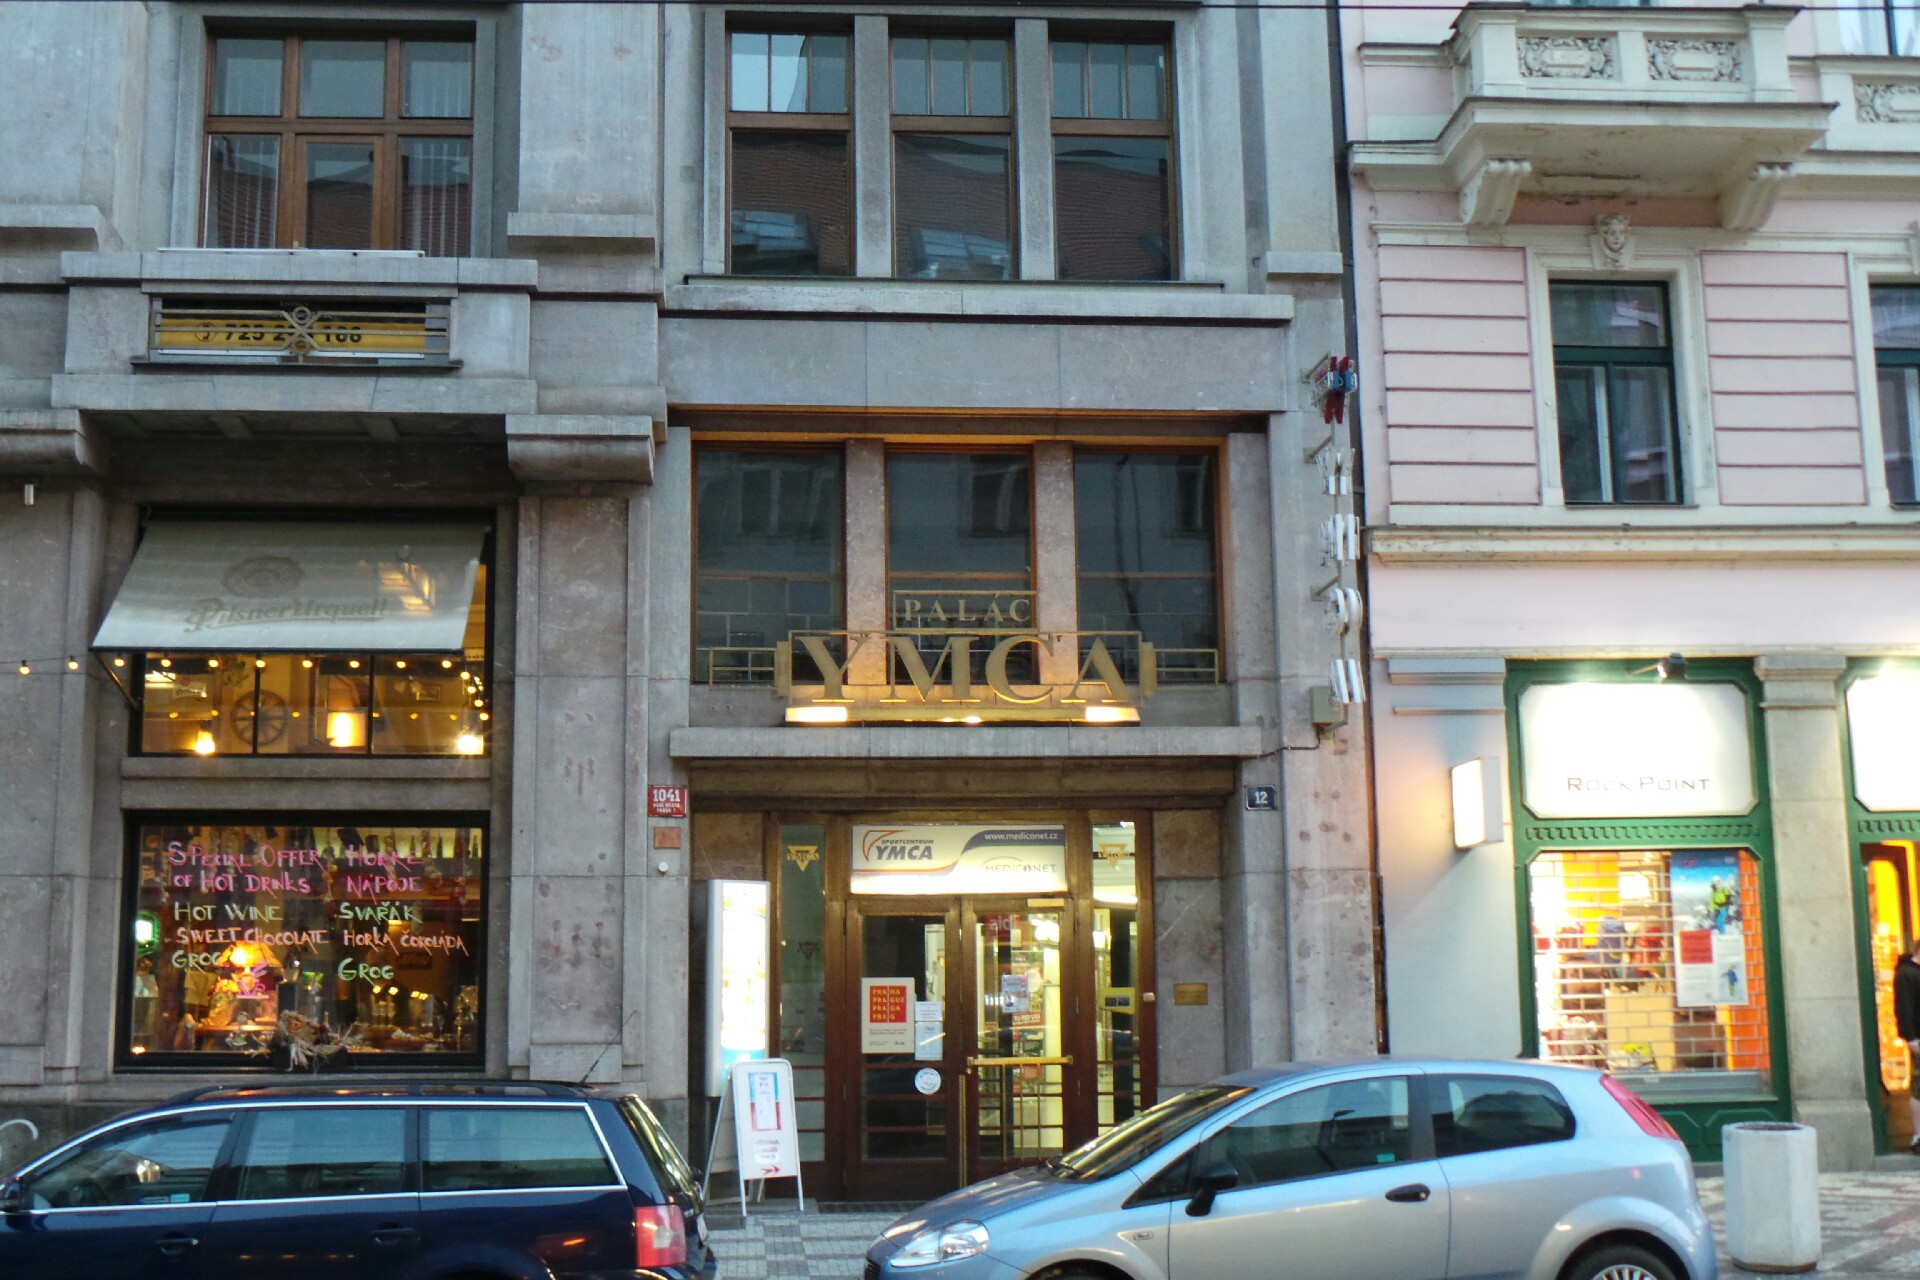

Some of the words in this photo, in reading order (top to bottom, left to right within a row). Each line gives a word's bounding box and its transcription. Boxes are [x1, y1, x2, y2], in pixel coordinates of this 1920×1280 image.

[225, 323, 265, 341] 725
[184, 598, 286, 632] Pilsner
[293, 598, 388, 623] Urquell
[904, 594, 1031, 622] PALÁC
[797, 634, 1134, 704] YMCA
[653, 788, 681, 802] 1041
[1254, 791, 1269, 804] 12
[984, 831, 1059, 841] www.mediconet.cz
[875, 845, 933, 861] YMCA
[200, 869, 237, 893] HOT
[346, 873, 424, 906] NÁPOJE
[174, 901, 217, 922] HOT
[224, 903, 284, 924] WINE
[339, 901, 424, 925] SVAŘÁK
[176, 926, 242, 945] SWEET
[244, 926, 329, 955] CHOCOLATE
